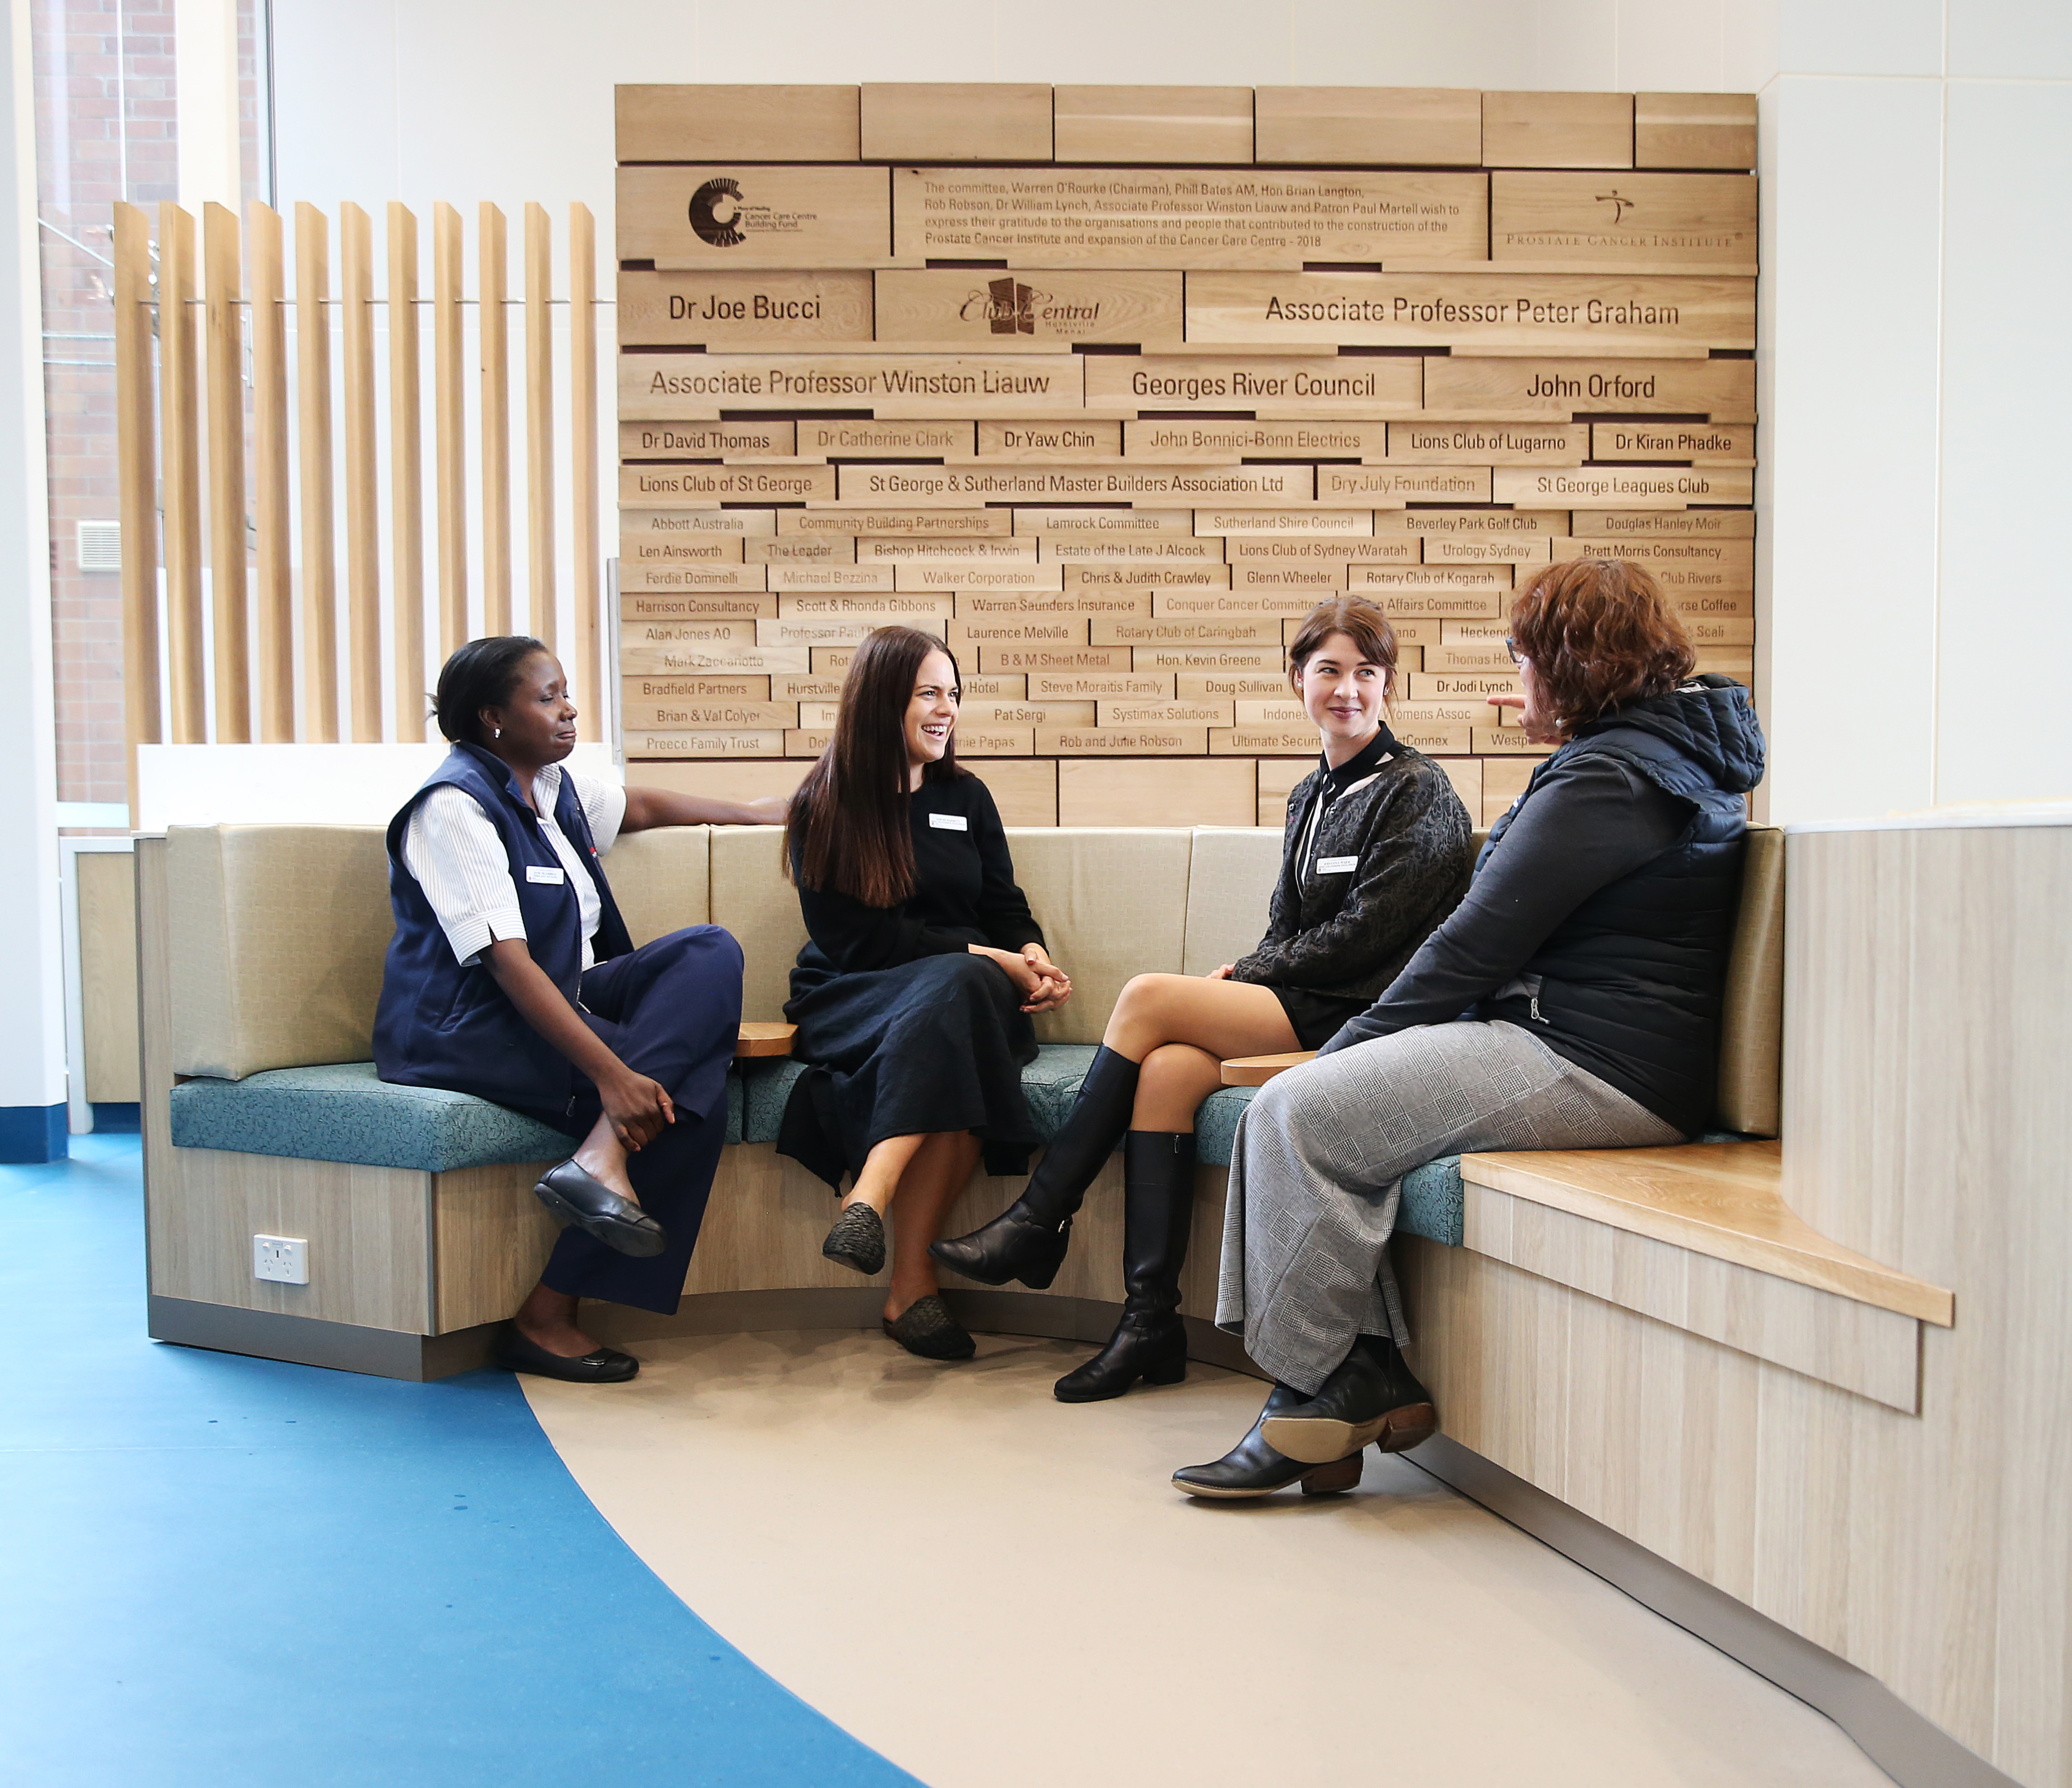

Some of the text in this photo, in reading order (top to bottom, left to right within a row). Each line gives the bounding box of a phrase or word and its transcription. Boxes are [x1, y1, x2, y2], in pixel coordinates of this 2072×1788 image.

[925, 183, 1364, 198] The committee, Warren O'Rourke (Chairman), Phill Bates AM, Hon Brian Langton,
[670, 295, 820, 320] Dr Joe Bucci
[960, 290, 1100, 322] Club Central
[1267, 297, 1679, 324] Associate Professor Peter Graham
[651, 370, 1050, 395] Associate Professor Winston Liauw
[1133, 372, 1375, 400] Georges River Council
[1528, 374, 1655, 398] John Orford
[643, 433, 770, 449] Dr David Thomas
[818, 431, 953, 447] Dr Catherine Clark
[1005, 432, 1094, 448] Dr Yaw Chin
[1151, 431, 1360, 447] John Bonnici-Bonn Electrics
[1412, 434, 1565, 453] Lions Club of Lugarno
[1616, 435, 1731, 451] Dr Kiran Phadke
[640, 476, 812, 494] Lions Club of St George
[870, 476, 1283, 494] St George & Sutherland Master Builders Association Ltd
[1332, 476, 1475, 494] Dry July Foundation
[1538, 477, 1709, 496] St George Leagues Club
[652, 518, 743, 530] Abbott Australia
[800, 517, 988, 530] Community Building Partnerships
[1047, 517, 1159, 529] Lamrock Committee
[1214, 517, 1353, 529] Sutherland Shire Council
[1407, 518, 1537, 532] Beverley Park Golf Club
[1606, 518, 1720, 532] Douglas Hanley Moir
[640, 545, 722, 557] Len Ainsworth
[876, 545, 1019, 558] Bishop Hitchcock & Irwin
[1057, 545, 1205, 556] Estate of the Late J Alcock
[1443, 544, 1531, 558] Urology Sydney
[1584, 545, 1721, 559] Brett Morris Consultancy
[1082, 572, 1210, 586] Chris & Judith Crawley
[1248, 572, 1331, 583] Glenn Wheeler
[1367, 572, 1494, 586] Rotary Club of Kogarah
[973, 600, 1135, 611] Warren Saunders Insurance
[647, 629, 731, 640] Alan Jones AO
[968, 627, 1068, 638] Laurence Melville
[1157, 654, 1261, 666] Hon. Kevin Greene
[644, 683, 747, 695] Bradfield Partners
[970, 682, 998, 693] Hotel
[1041, 681, 1162, 695] Steve Moraitis Family
[1206, 681, 1282, 694] Doug Sullivan
[1437, 681, 1512, 694] Dr Jodi Lynch
[995, 709, 1046, 722] Pat Sergi
[1113, 708, 1218, 722] Systimax Solutions
[1061, 735, 1182, 747] Rob and Julie Robson
